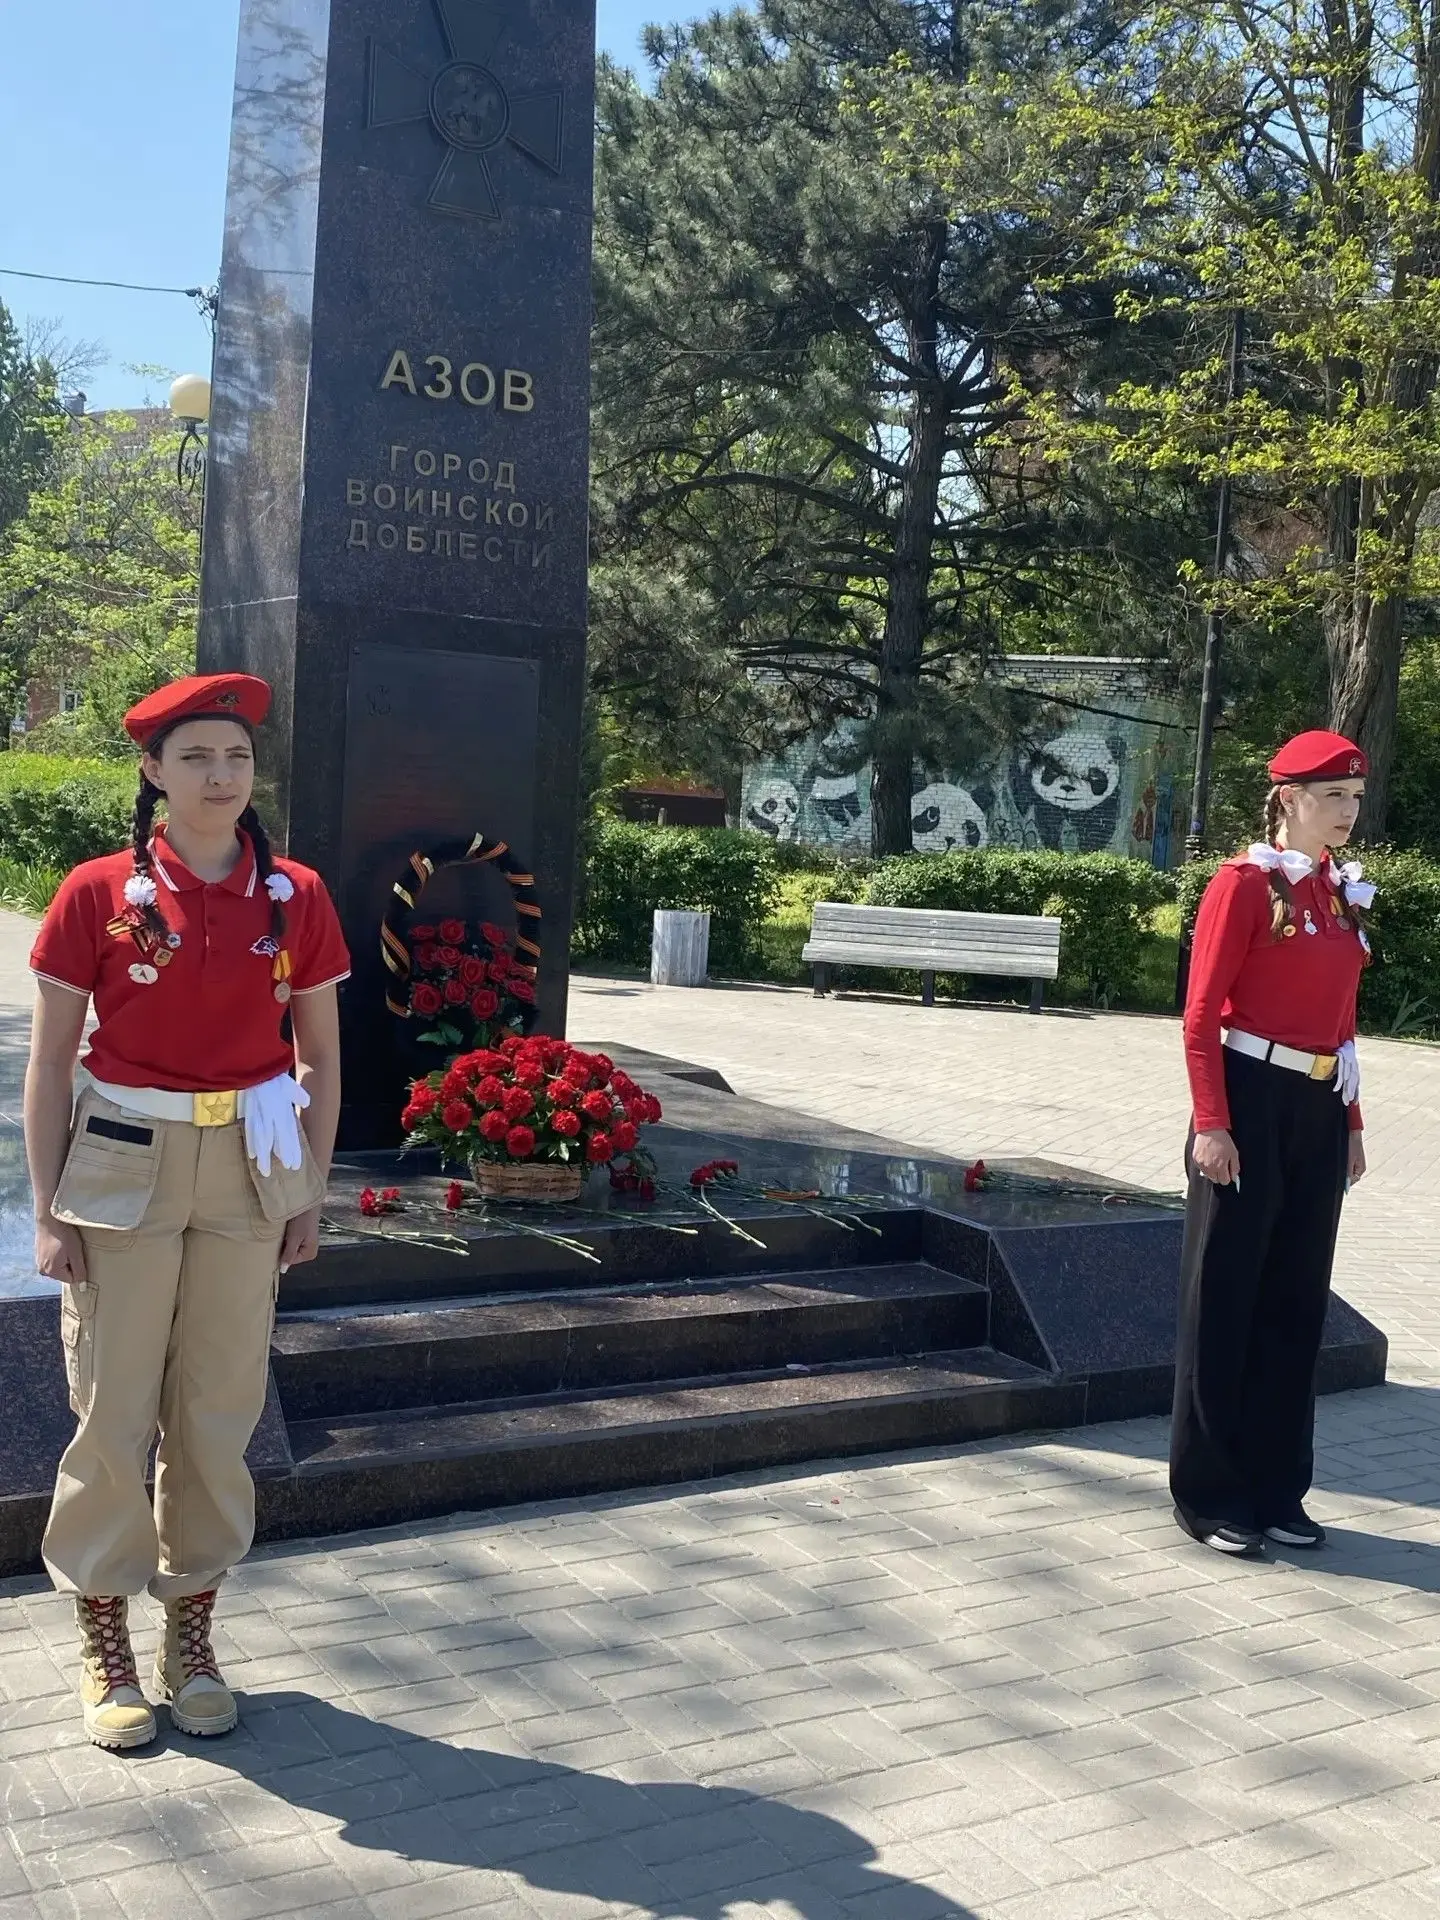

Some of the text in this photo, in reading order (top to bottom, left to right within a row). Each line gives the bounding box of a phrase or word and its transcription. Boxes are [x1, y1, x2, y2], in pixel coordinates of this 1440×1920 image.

[379, 350, 535, 412] АЗОВ
[390, 445, 516, 493] ГОРОД
[346, 479, 554, 530] ВОИНСКОЙ
[346, 519, 551, 568] ДОБЛЕСТИ
